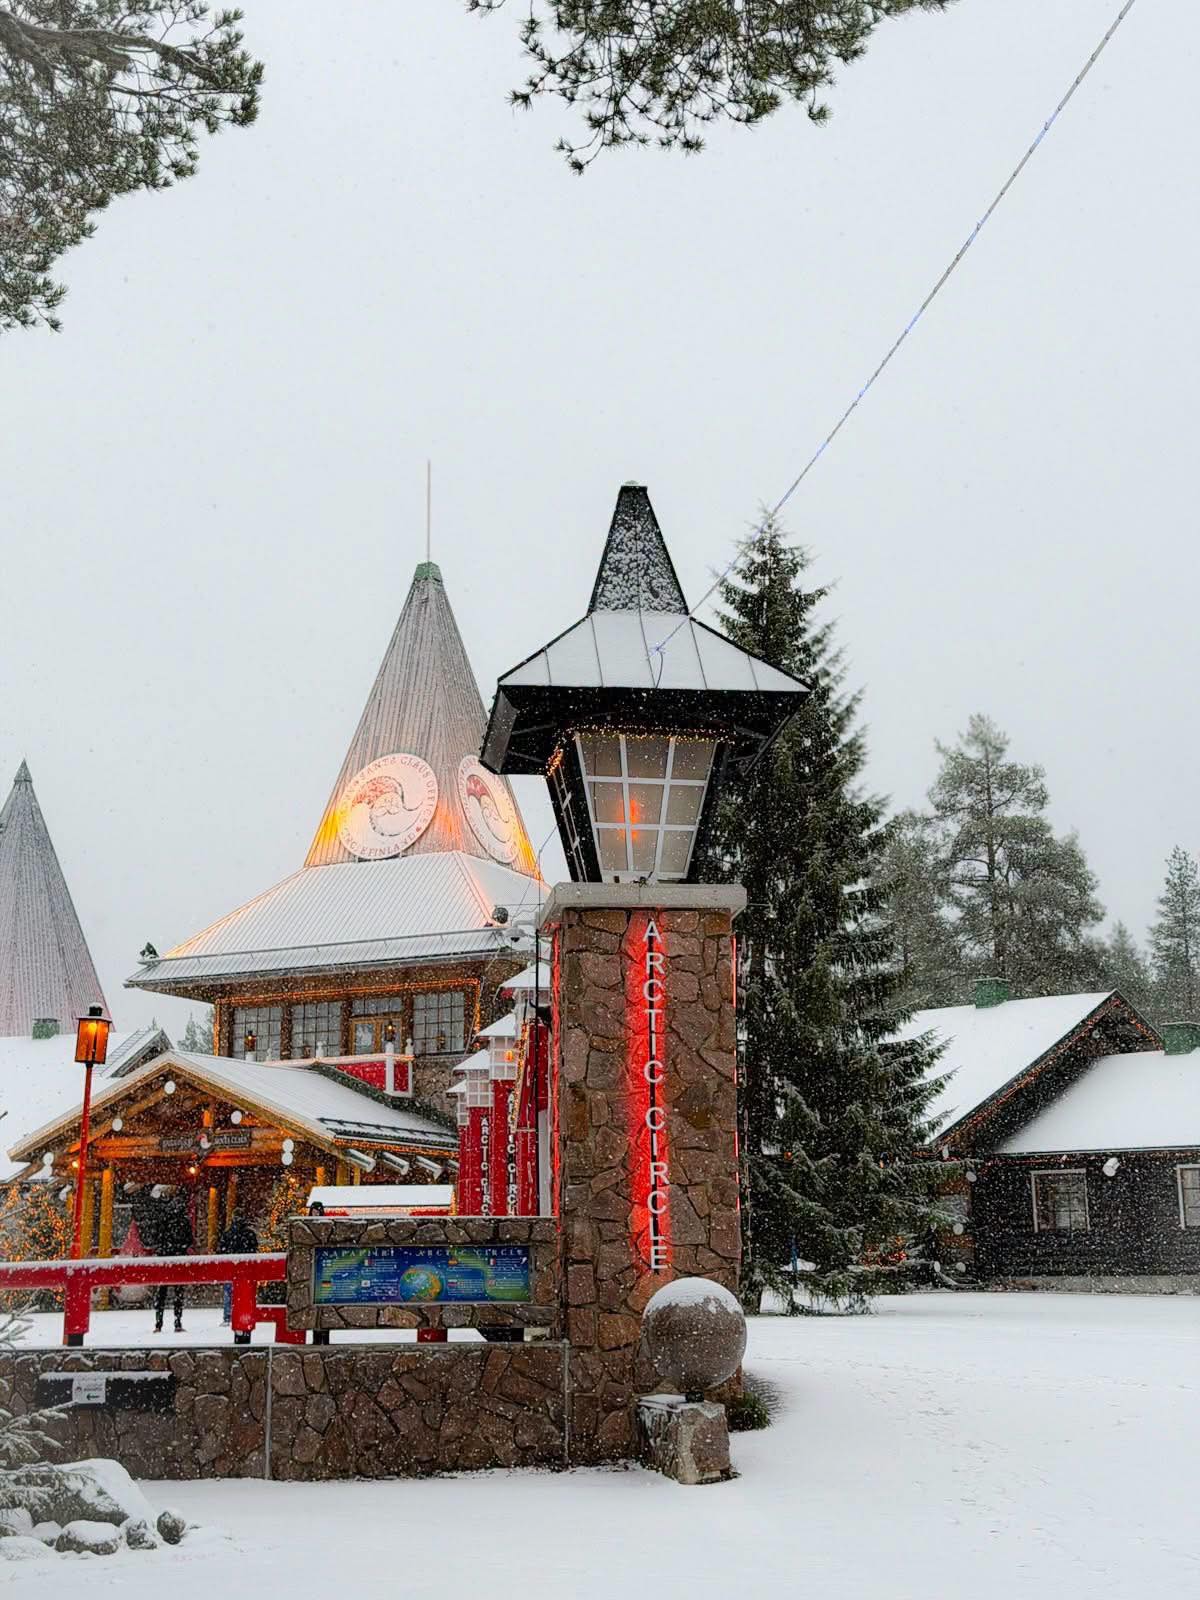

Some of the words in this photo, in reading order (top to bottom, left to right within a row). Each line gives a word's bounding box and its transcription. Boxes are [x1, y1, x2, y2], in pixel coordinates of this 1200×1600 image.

[359, 756, 397, 781] SANTA
[400, 755, 430, 780] CLAUS
[421, 780, 436, 826] OFFICE
[367, 833, 417, 857] FINLAND
[642, 920, 665, 1084] ARCTIC
[481, 1117, 490, 1171] ARCTIC
[507, 1093, 517, 1155] ACIC
[507, 1162, 517, 1217] CIRCL
[644, 1106, 670, 1270] CIRCLE
